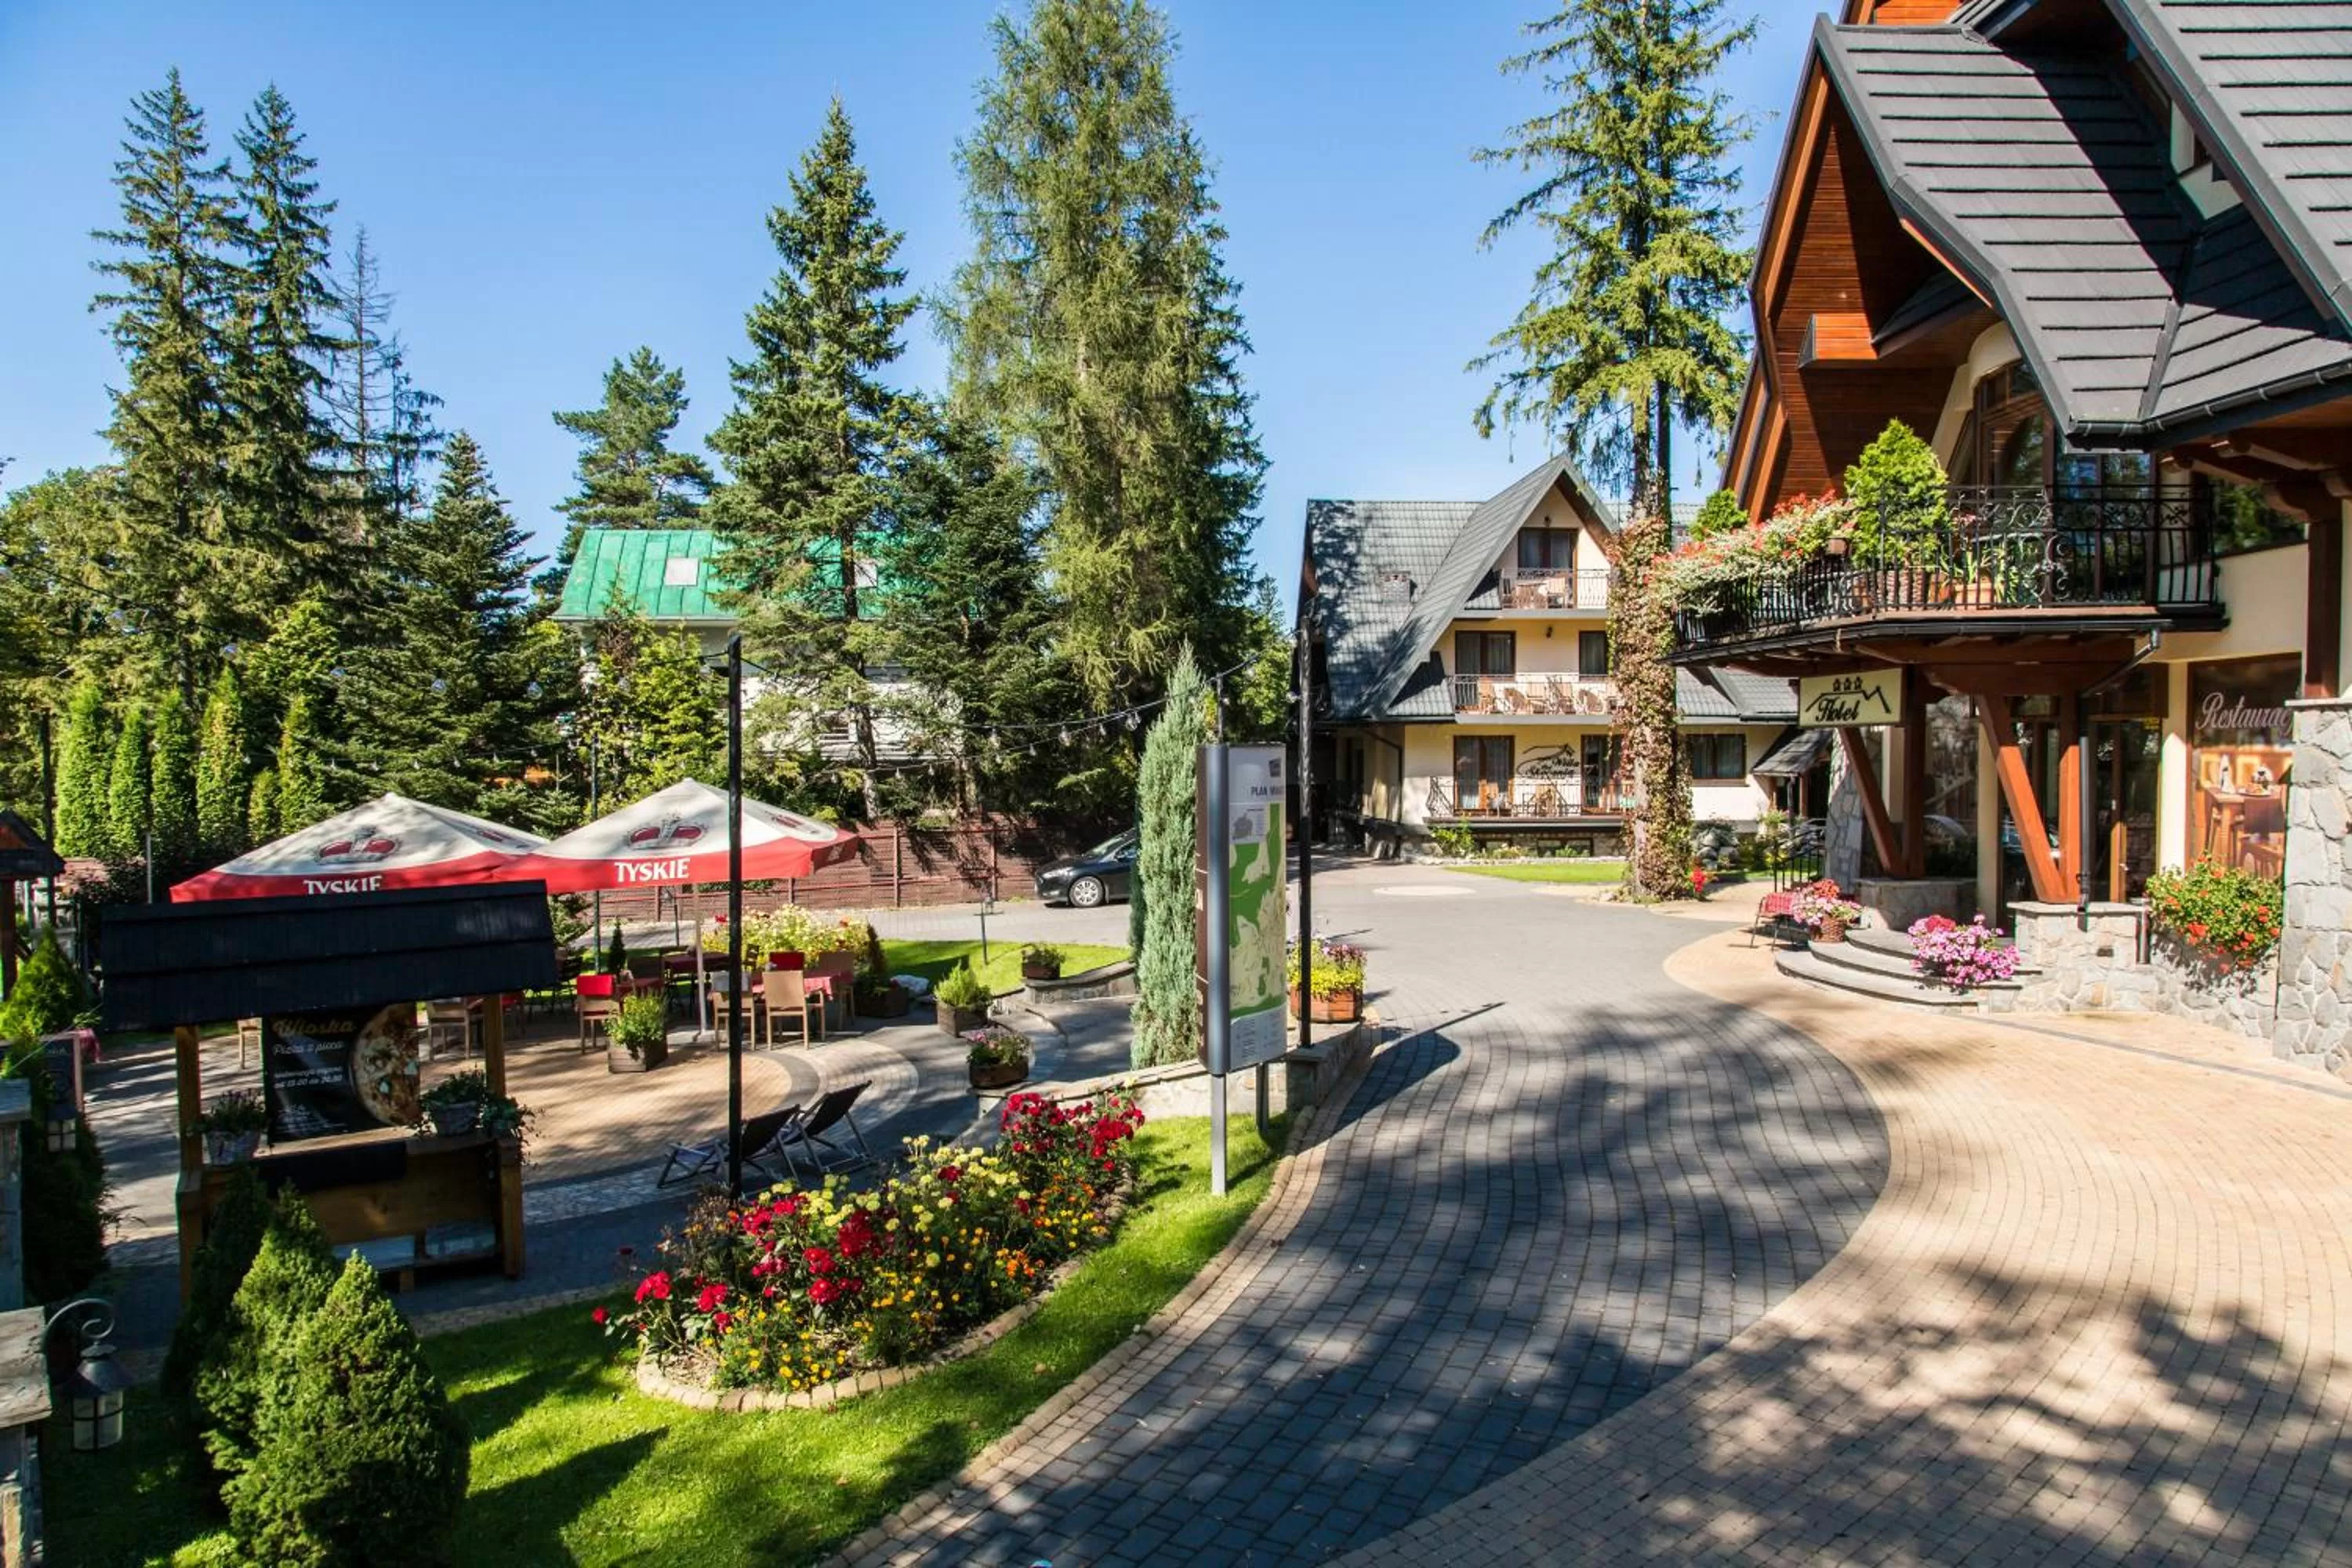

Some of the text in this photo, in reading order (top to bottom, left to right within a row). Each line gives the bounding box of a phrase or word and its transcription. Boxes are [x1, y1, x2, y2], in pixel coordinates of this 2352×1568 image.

[1816, 695, 1860, 721] Hotel
[614, 858, 691, 883] TYSKIE
[303, 875, 383, 895] TYSKIE
